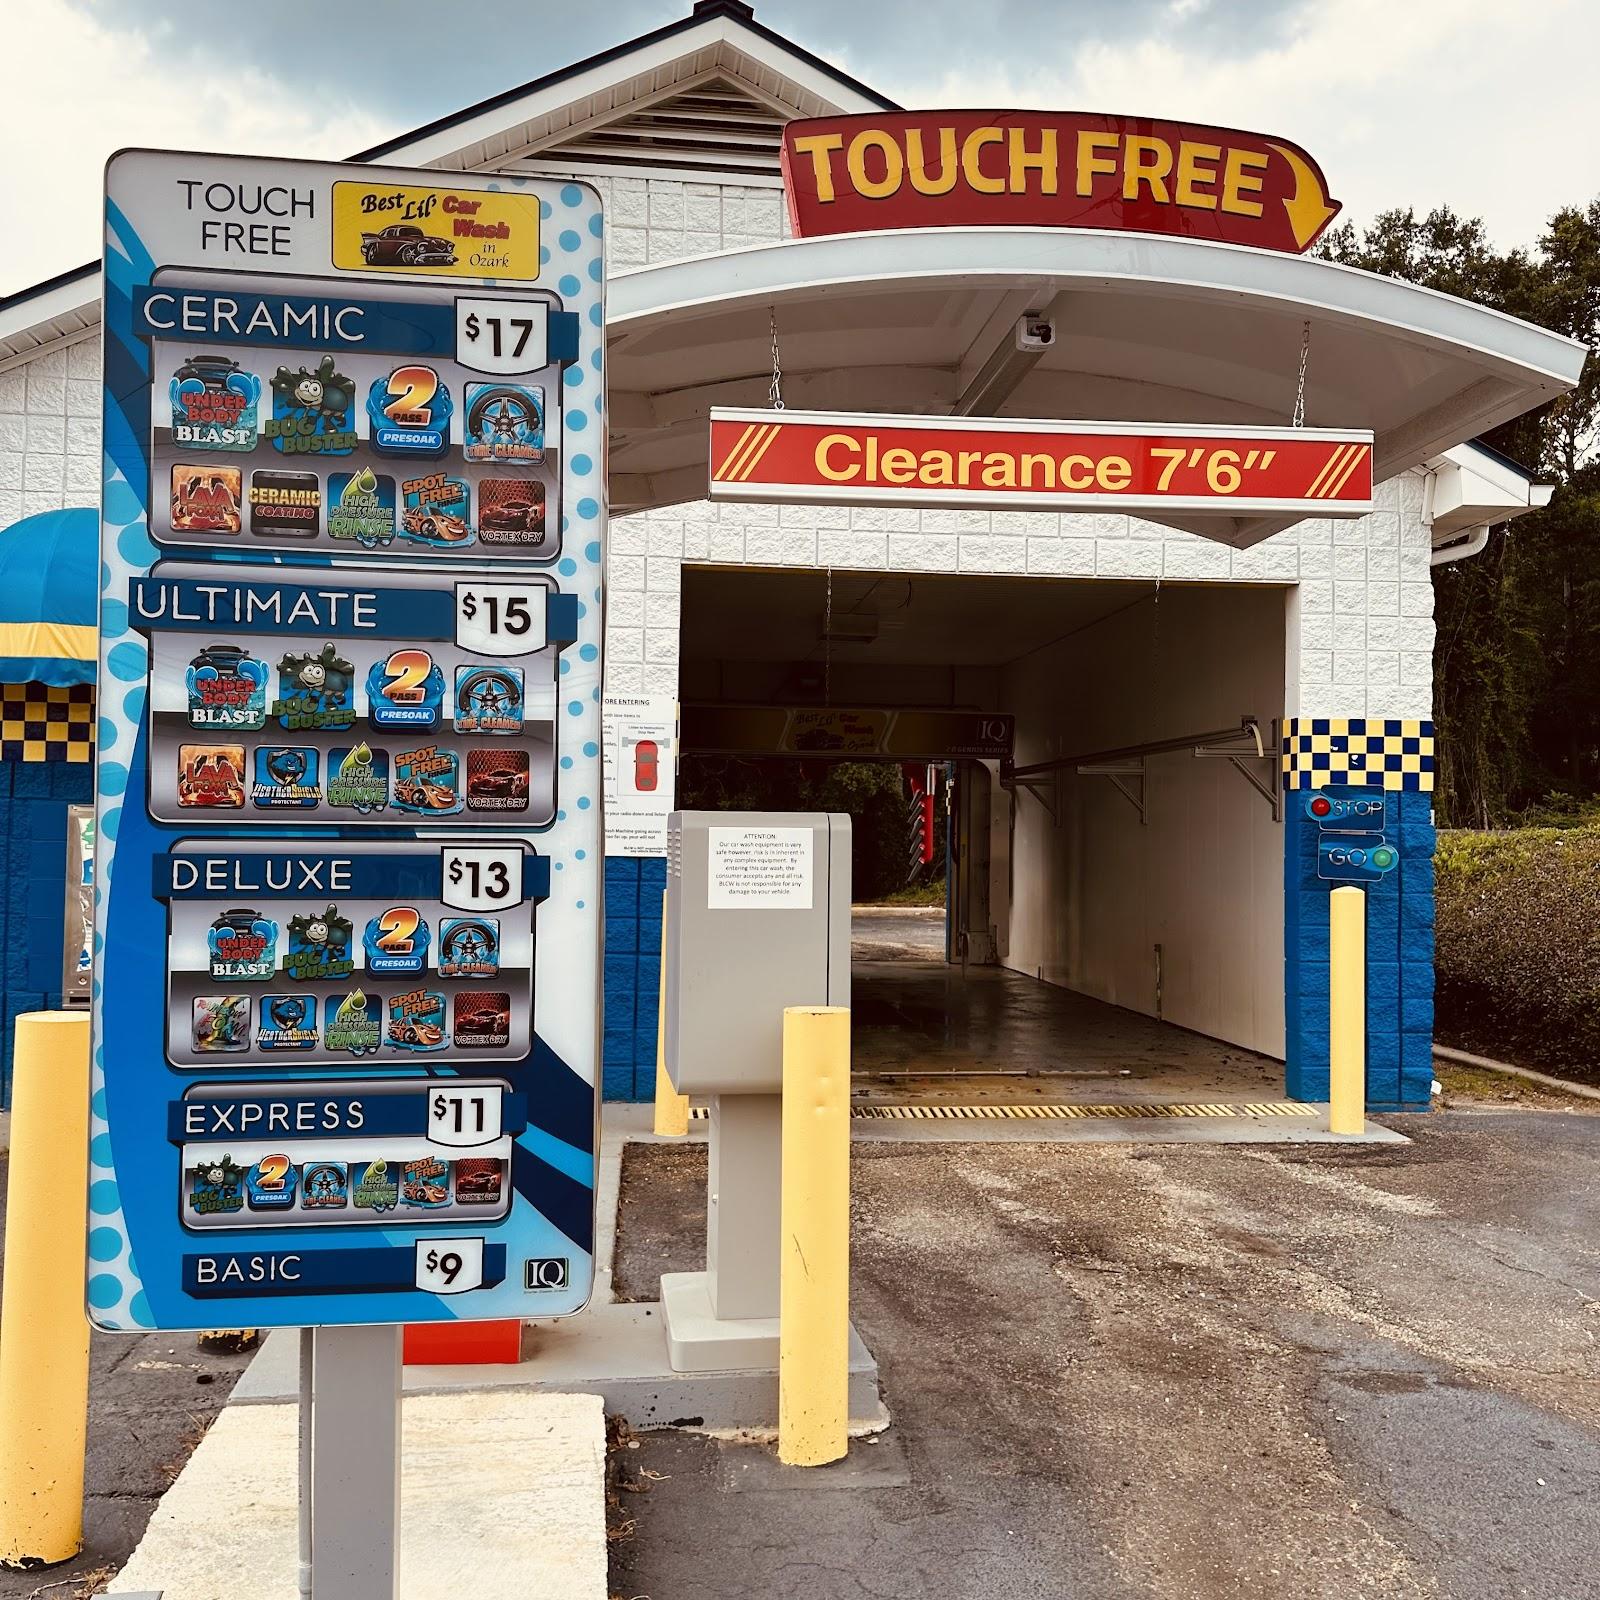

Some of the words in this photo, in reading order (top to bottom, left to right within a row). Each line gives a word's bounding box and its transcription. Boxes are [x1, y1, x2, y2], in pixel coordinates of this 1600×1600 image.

[794, 126, 1058, 203] TOUCH
[1076, 130, 1270, 218] FREE
[177, 180, 314, 218] TOUCH
[361, 192, 404, 214] Best
[441, 195, 481, 215] Car
[202, 220, 290, 256] FREE
[452, 218, 510, 240] Wash
[482, 241, 496, 254] in
[469, 253, 508, 268] Ozark
[143, 294, 365, 342] CERAMIC
[465, 313, 533, 357] $17
[181, 391, 247, 410] UNDER
[384, 366, 437, 426] 2
[188, 407, 242, 424] BODY
[392, 413, 422, 423] PASS
[176, 426, 251, 445] BLAST
[264, 416, 317, 438] BUG
[283, 431, 359, 454] BUSTER
[382, 433, 437, 444] PRESOAK
[814, 433, 1132, 490] Clearance
[402, 472, 448, 495] SPOT
[179, 482, 233, 507] LAVA
[249, 488, 321, 507] CERAMIC
[344, 495, 379, 508] HIGH
[419, 484, 463, 506] FREE
[186, 505, 225, 522] FOAM
[255, 506, 315, 519] COATING
[330, 506, 394, 519] PRESSURE
[330, 518, 394, 538] RINSE
[480, 530, 520, 542] VORTEX
[521, 531, 544, 543] DRY
[136, 584, 377, 627] ULTIMATE
[462, 592, 531, 635] $15
[197, 679, 256, 692] UNDER
[382, 650, 432, 704] 2
[203, 693, 250, 706] BODY
[390, 692, 417, 701] PASS
[191, 708, 259, 724] BLAST
[271, 697, 319, 717] BUG
[380, 711, 431, 720] PRESOAK
[288, 709, 357, 730] BUSTER
[981, 720, 1006, 742] IQ
[395, 745, 437, 767] SPOT
[186, 761, 238, 785] LAVA
[342, 766, 375, 778] HIGH
[411, 756, 452, 777] FREE
[329, 777, 387, 788] PRESSURE
[329, 788, 387, 805] RINSE
[467, 798, 507, 808] VORTEX
[507, 798, 527, 808] DRY
[1333, 800, 1383, 816] STOP
[1328, 847, 1367, 866] GO
[172, 860, 352, 890] DELUXE
[448, 858, 510, 899] $13
[377, 907, 420, 953] 2
[217, 938, 267, 949] UNDER
[383, 943, 407, 951] PASS
[222, 949, 263, 960] BODY
[282, 952, 321, 969] BUG
[212, 963, 270, 976] BLAST
[296, 960, 355, 979] BUSTER
[389, 989, 428, 1009] SPOT
[403, 997, 440, 1017] FREE
[338, 1011, 368, 1023] HIGH
[326, 1031, 380, 1048] RINSE
[455, 1035, 490, 1045] VORTEX
[185, 1101, 364, 1133] EXPRESS
[433, 1094, 484, 1133] $11
[256, 1154, 290, 1190] 2
[404, 1156, 435, 1173] SPOT
[190, 1191, 220, 1205] BUG
[199, 1197, 244, 1214] BUSTER
[197, 1255, 301, 1283] BASIC
[426, 1249, 462, 1284] $9
[530, 1261, 565, 1289] IQ
